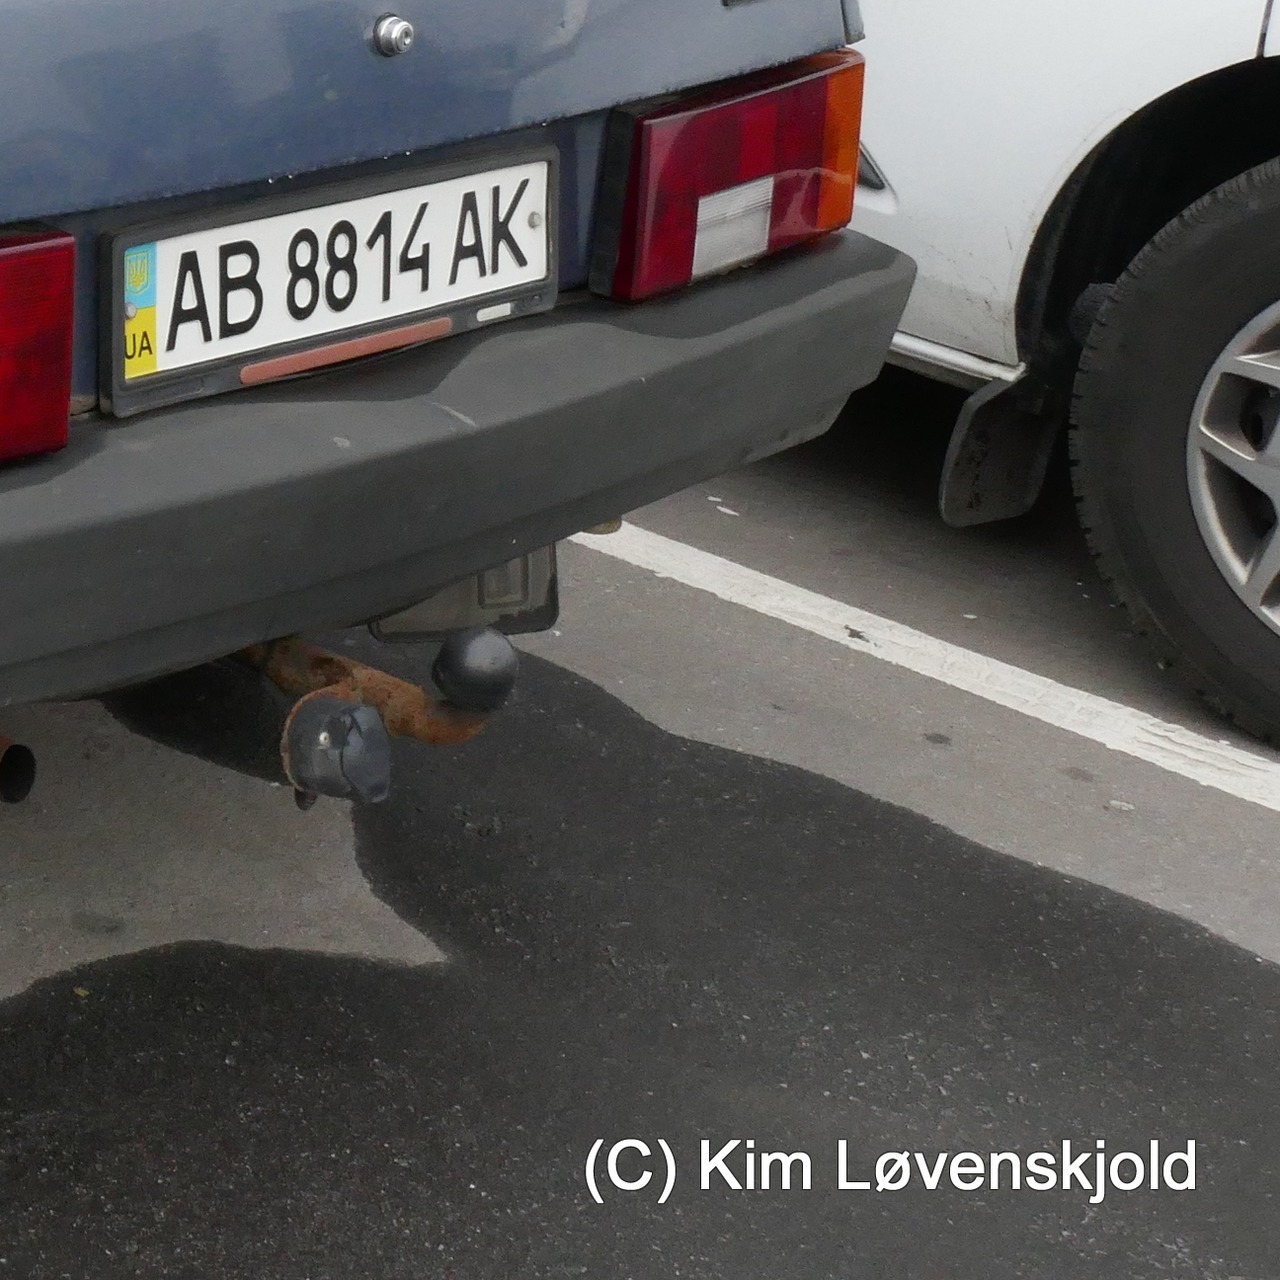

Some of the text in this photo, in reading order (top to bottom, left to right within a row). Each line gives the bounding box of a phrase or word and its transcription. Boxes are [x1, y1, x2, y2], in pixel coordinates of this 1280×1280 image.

[166, 177, 531, 352] AB 8814 AK
[123, 330, 154, 360] UA
